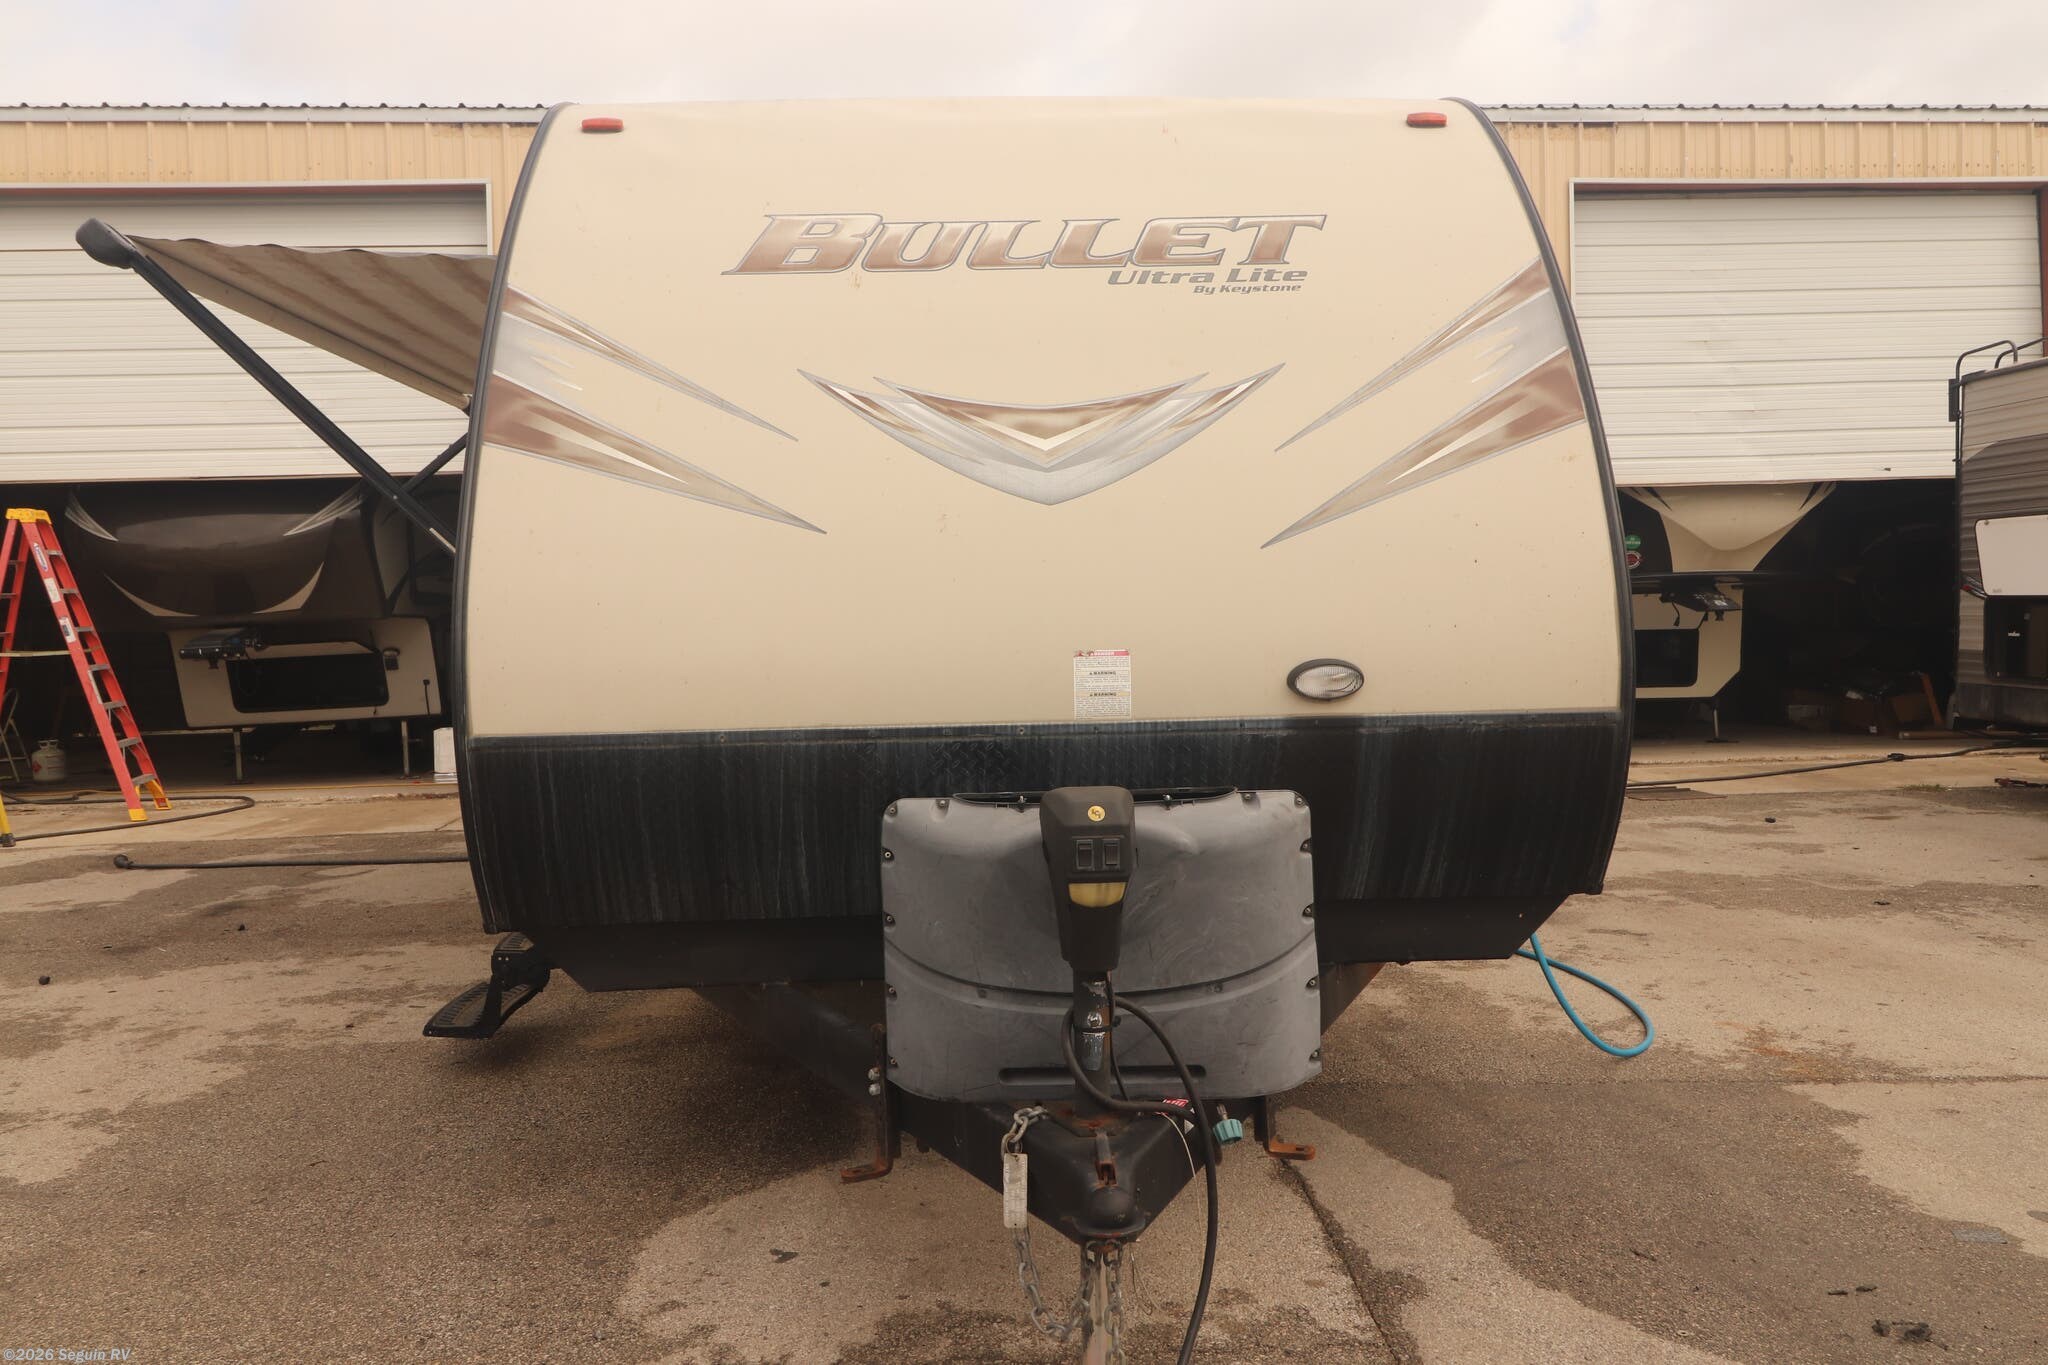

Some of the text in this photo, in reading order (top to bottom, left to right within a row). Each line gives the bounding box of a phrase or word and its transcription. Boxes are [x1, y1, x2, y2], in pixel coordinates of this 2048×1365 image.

[720, 213, 1328, 275] BULLET
[1107, 267, 1308, 285] Ultra Lite
[1193, 284, 1302, 295] By Keystone
